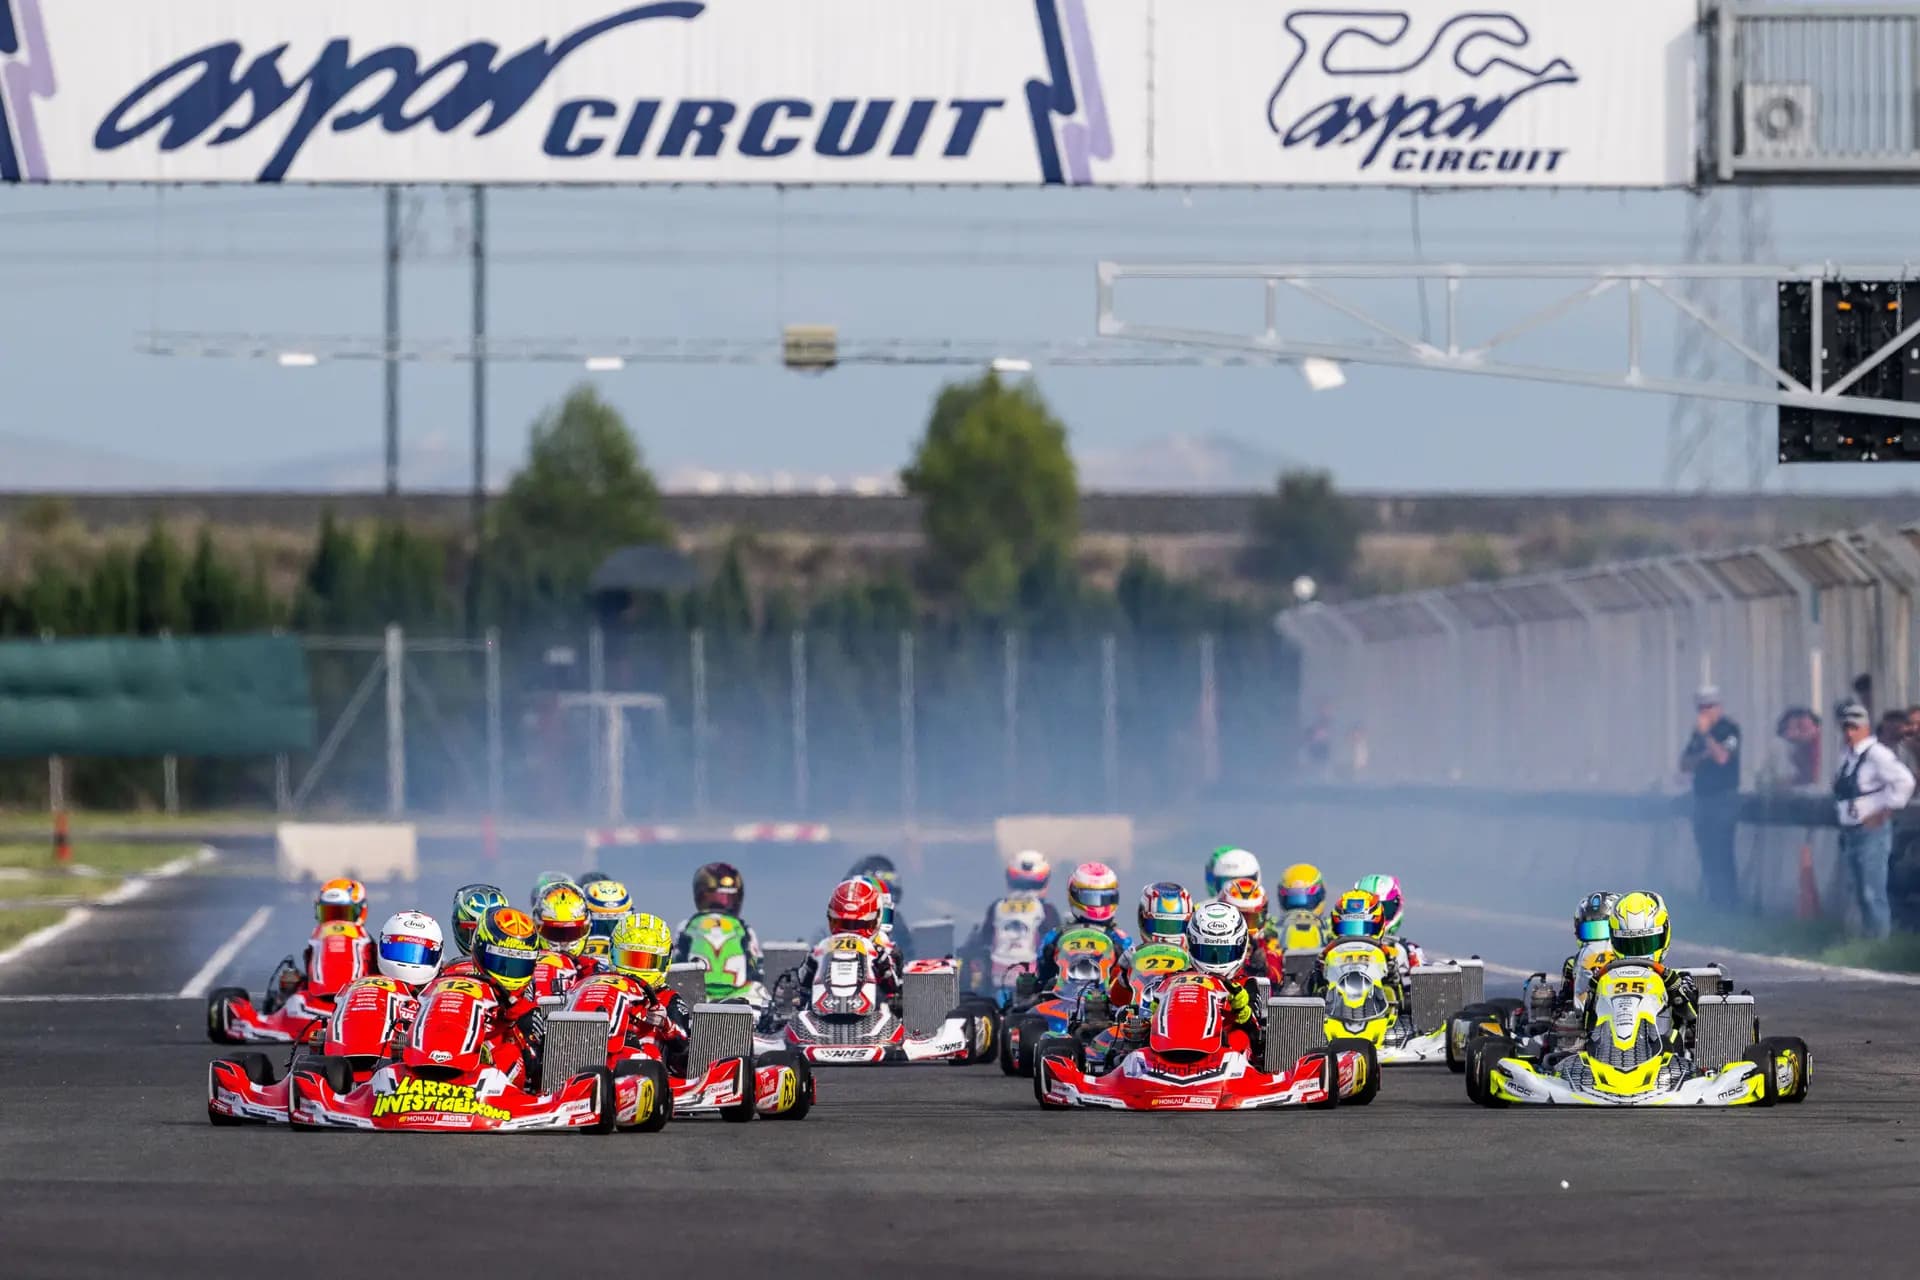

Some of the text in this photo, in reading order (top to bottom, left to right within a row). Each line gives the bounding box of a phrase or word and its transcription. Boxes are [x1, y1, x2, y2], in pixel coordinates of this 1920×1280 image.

[543, 99, 1004, 158] CIRCUIT
[1392, 151, 1567, 171] CIRCUIT
[834, 938, 857, 950] 26
[1145, 958, 1175, 970] 27
[443, 981, 475, 992] 12
[1615, 982, 1645, 993] 35
[395, 1076, 476, 1099] LARRY'S
[1158, 1096, 1213, 1105] MONLAU MOTUL
[442, 1114, 468, 1122] MOTUL
